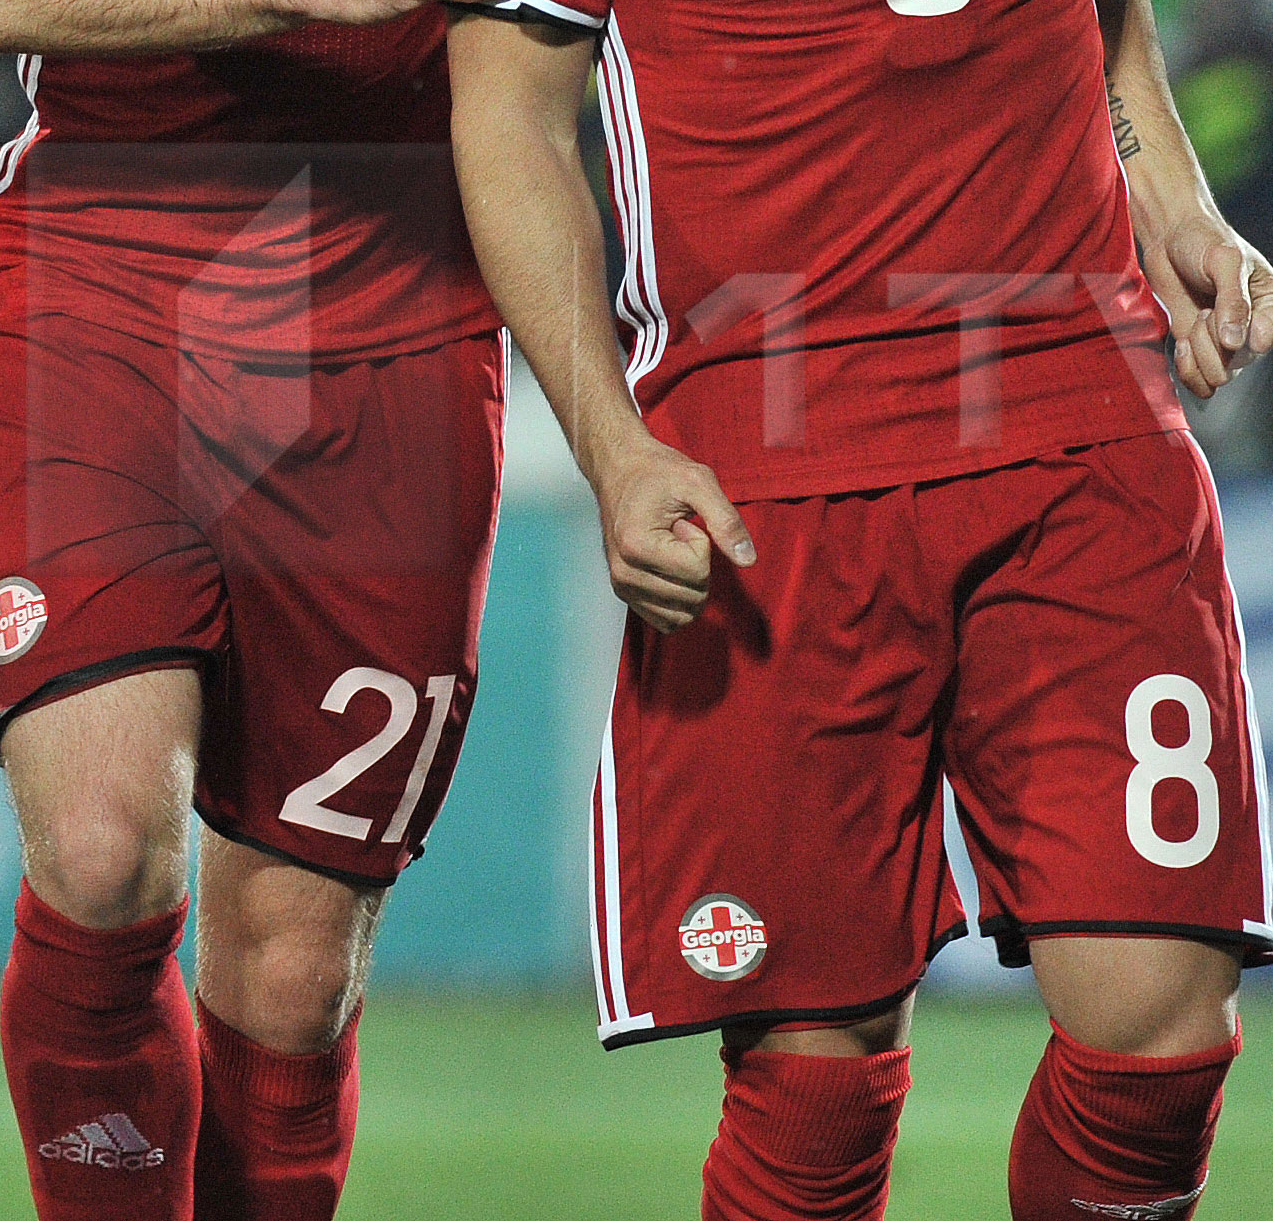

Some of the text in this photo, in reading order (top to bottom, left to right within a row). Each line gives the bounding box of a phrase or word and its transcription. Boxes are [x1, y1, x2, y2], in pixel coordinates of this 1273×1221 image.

[277, 665, 457, 845] 21
[1124, 673, 1221, 869] 8
[682, 924, 765, 951] Georgia
